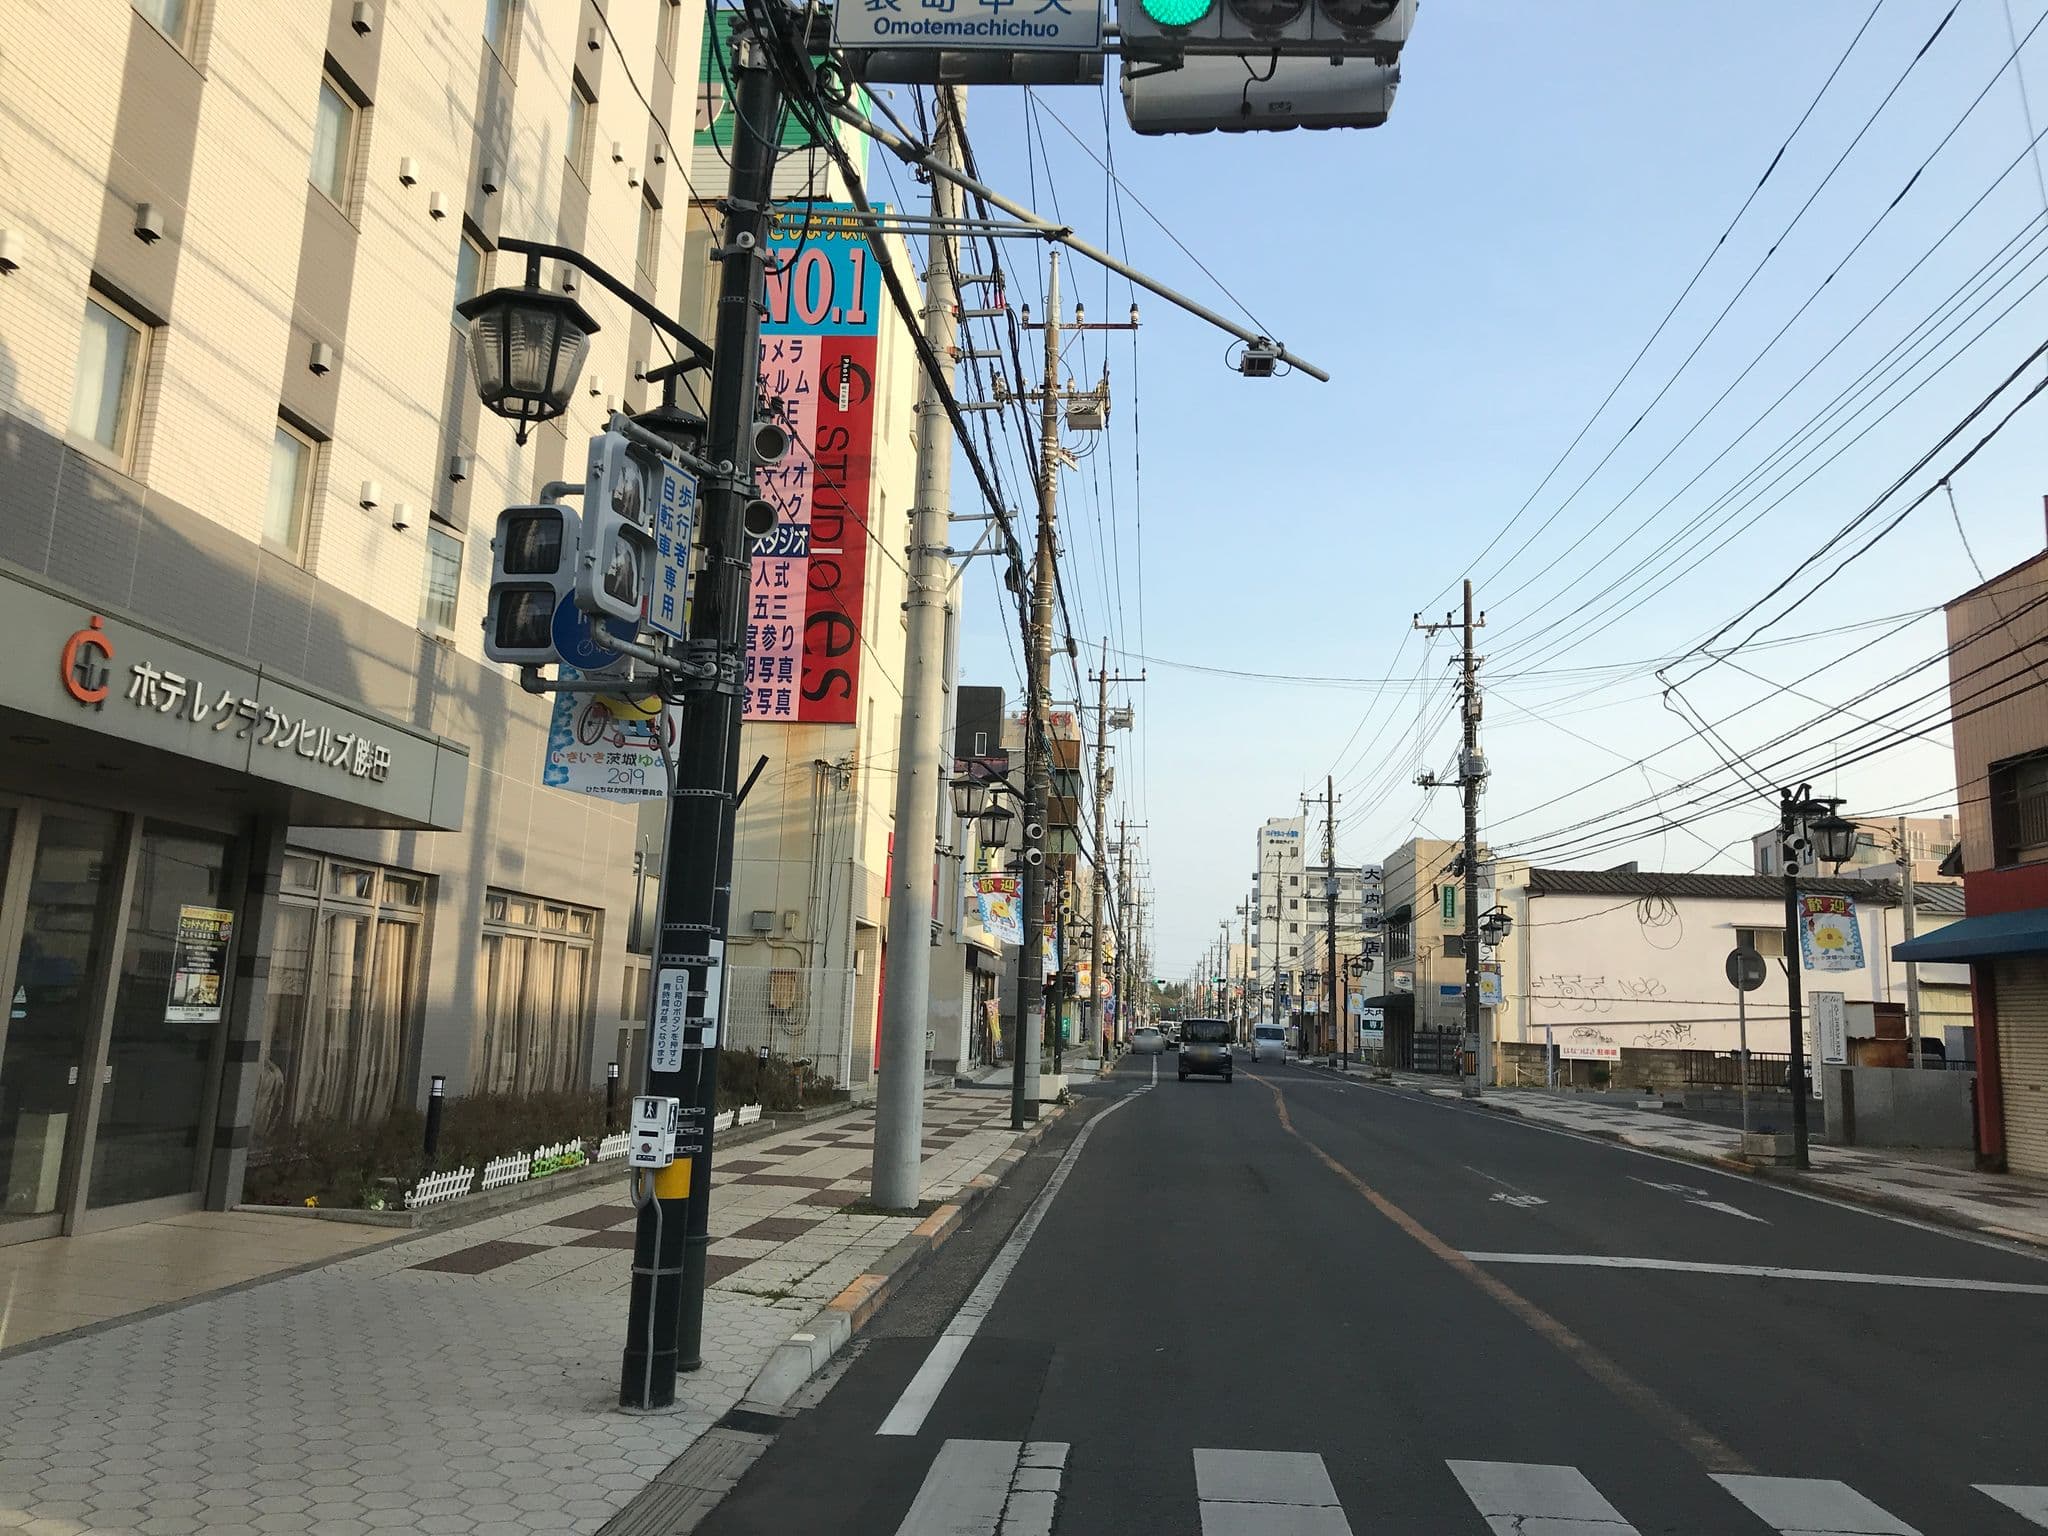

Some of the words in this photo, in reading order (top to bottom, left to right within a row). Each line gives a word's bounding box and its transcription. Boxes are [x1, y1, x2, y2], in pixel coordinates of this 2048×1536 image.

[873, 16, 1060, 38] Omotemachichuo
[808, 425, 850, 592] STUDIO
[674, 483, 692, 569] 歩行者
[608, 767, 645, 785] 2019
[980, 879, 1015, 894] 歓迎
[1807, 897, 1846, 914] 歓迎
[668, 975, 684, 1067] 白い箱のボタンを押すと
